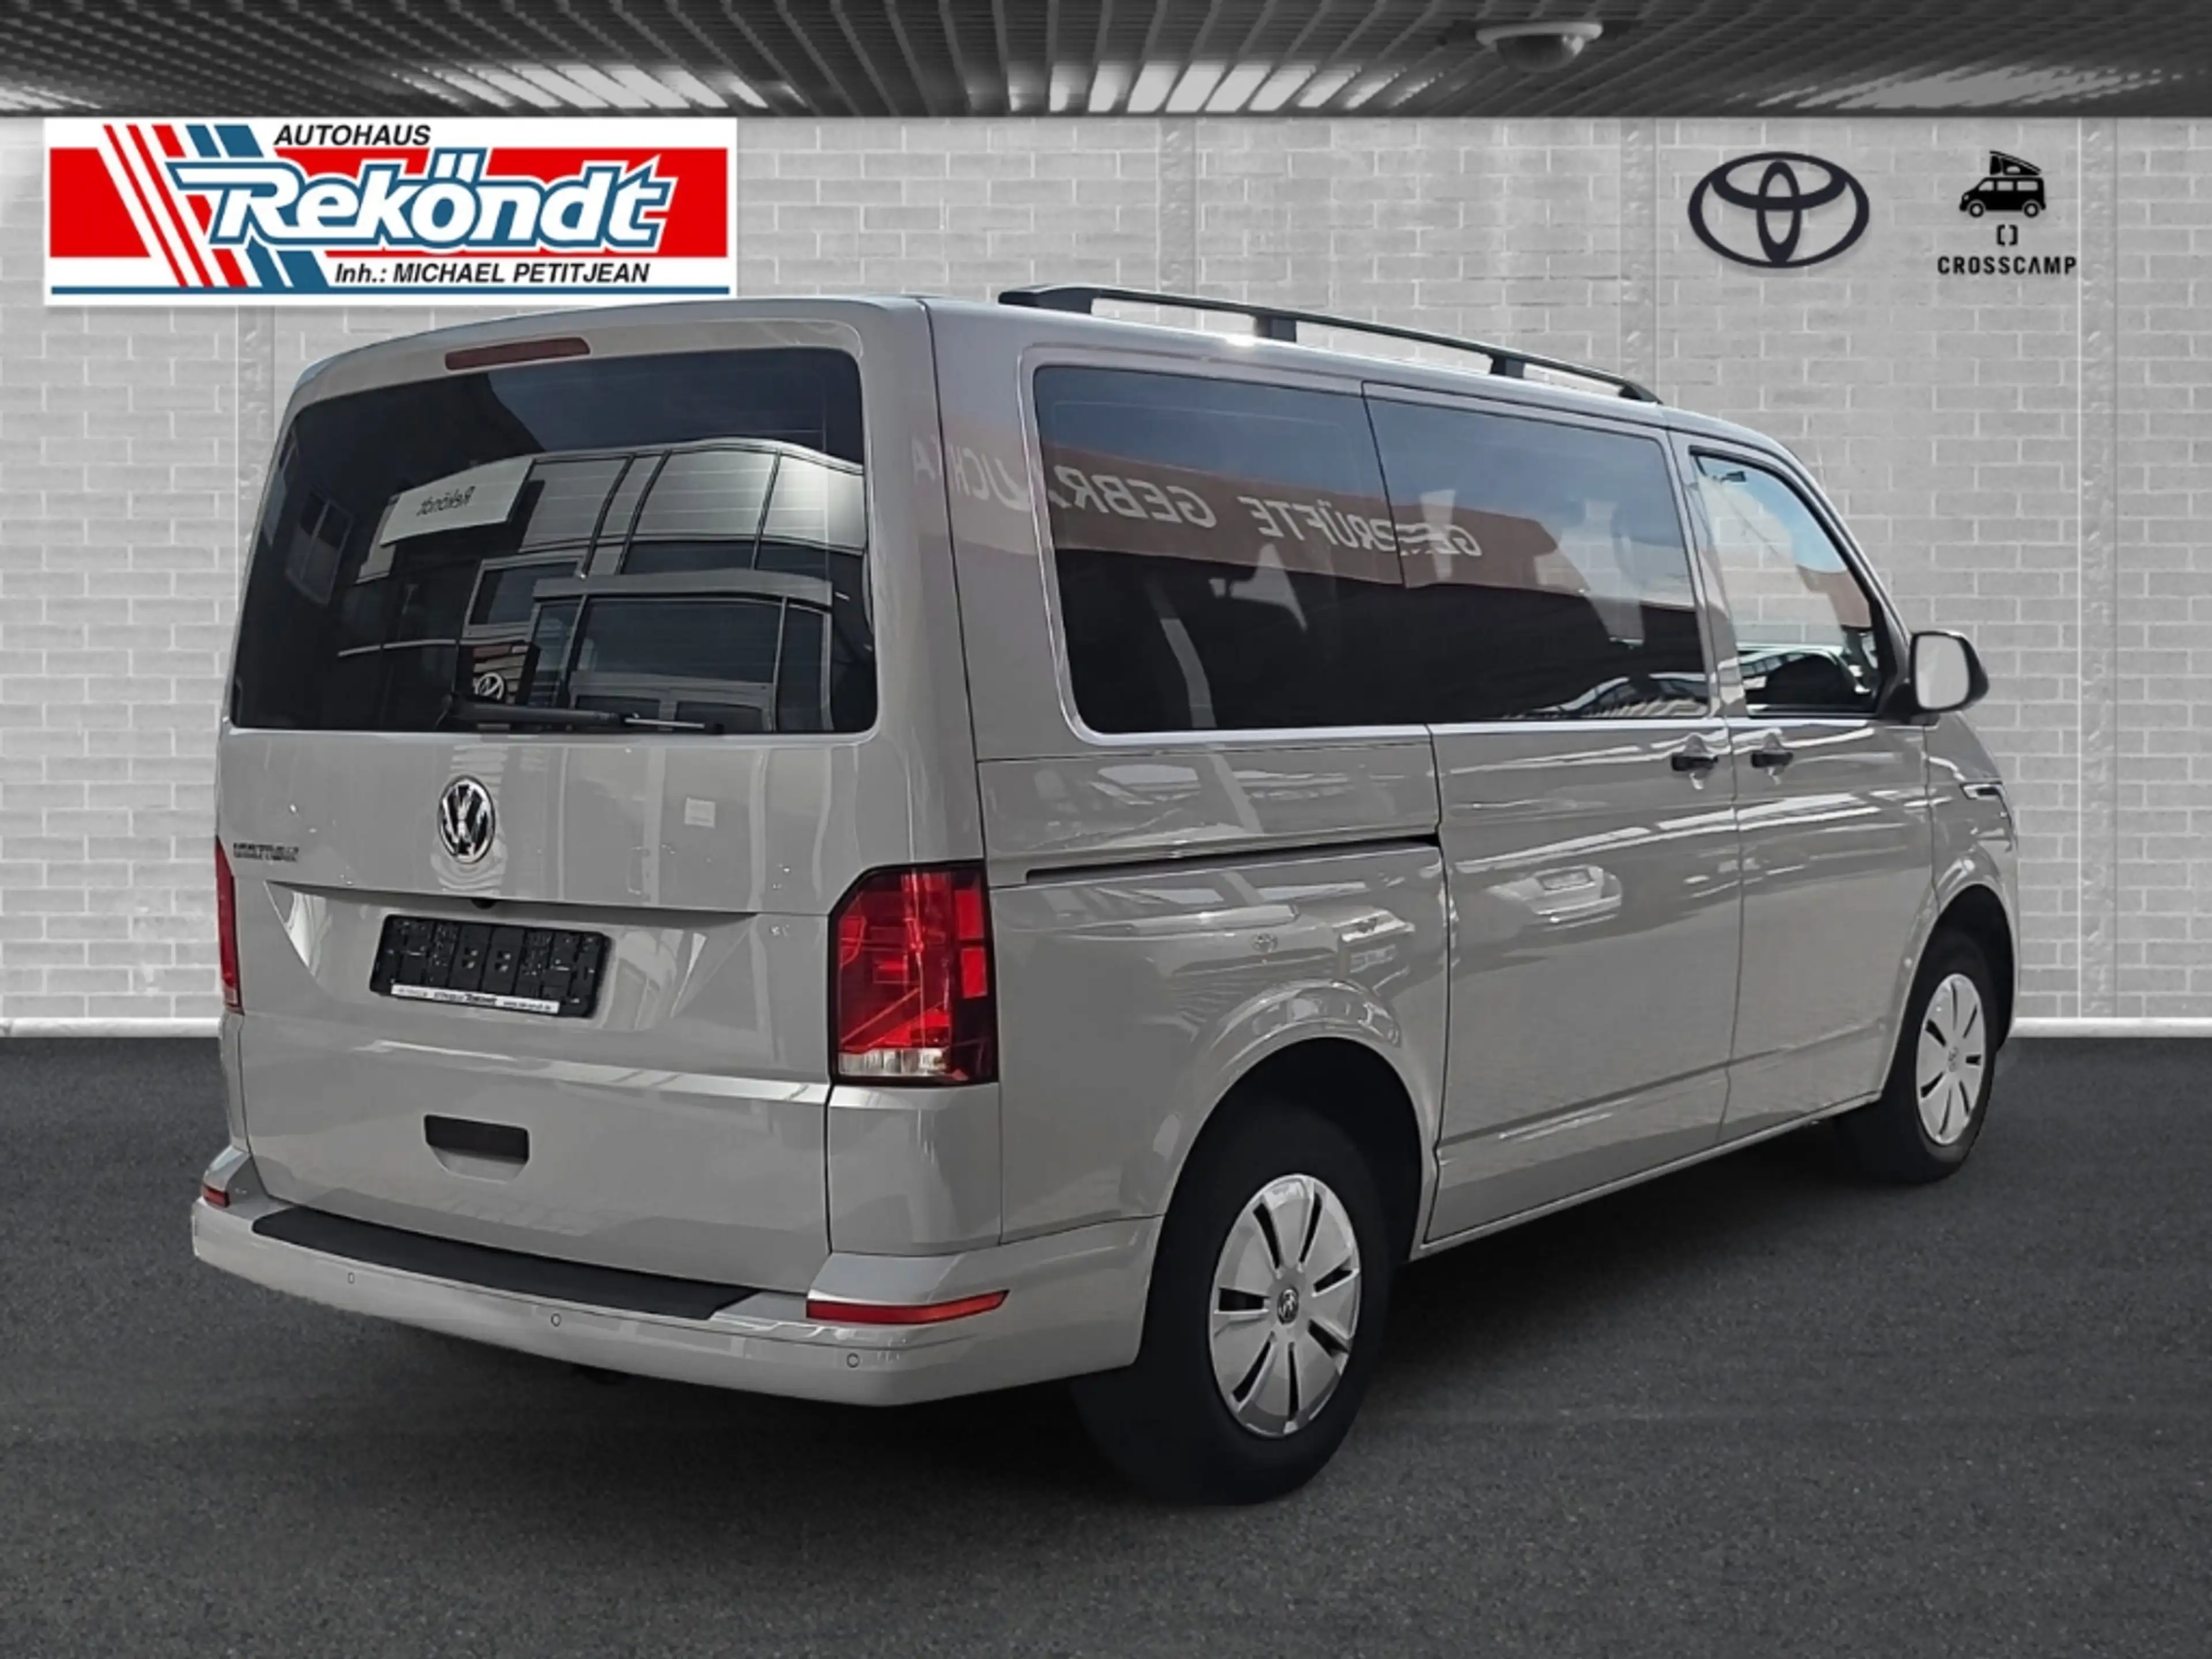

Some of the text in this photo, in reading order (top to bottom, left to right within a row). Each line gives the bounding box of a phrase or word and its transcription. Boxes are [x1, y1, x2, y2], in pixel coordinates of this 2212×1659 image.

[274, 124, 431, 146] AUTOHAUS
[165, 147, 672, 248] Reköndt
[335, 263, 651, 283] Inh.: MICHAEL PETITJEAN
[1937, 256, 2078, 275] CROSSCAMP
